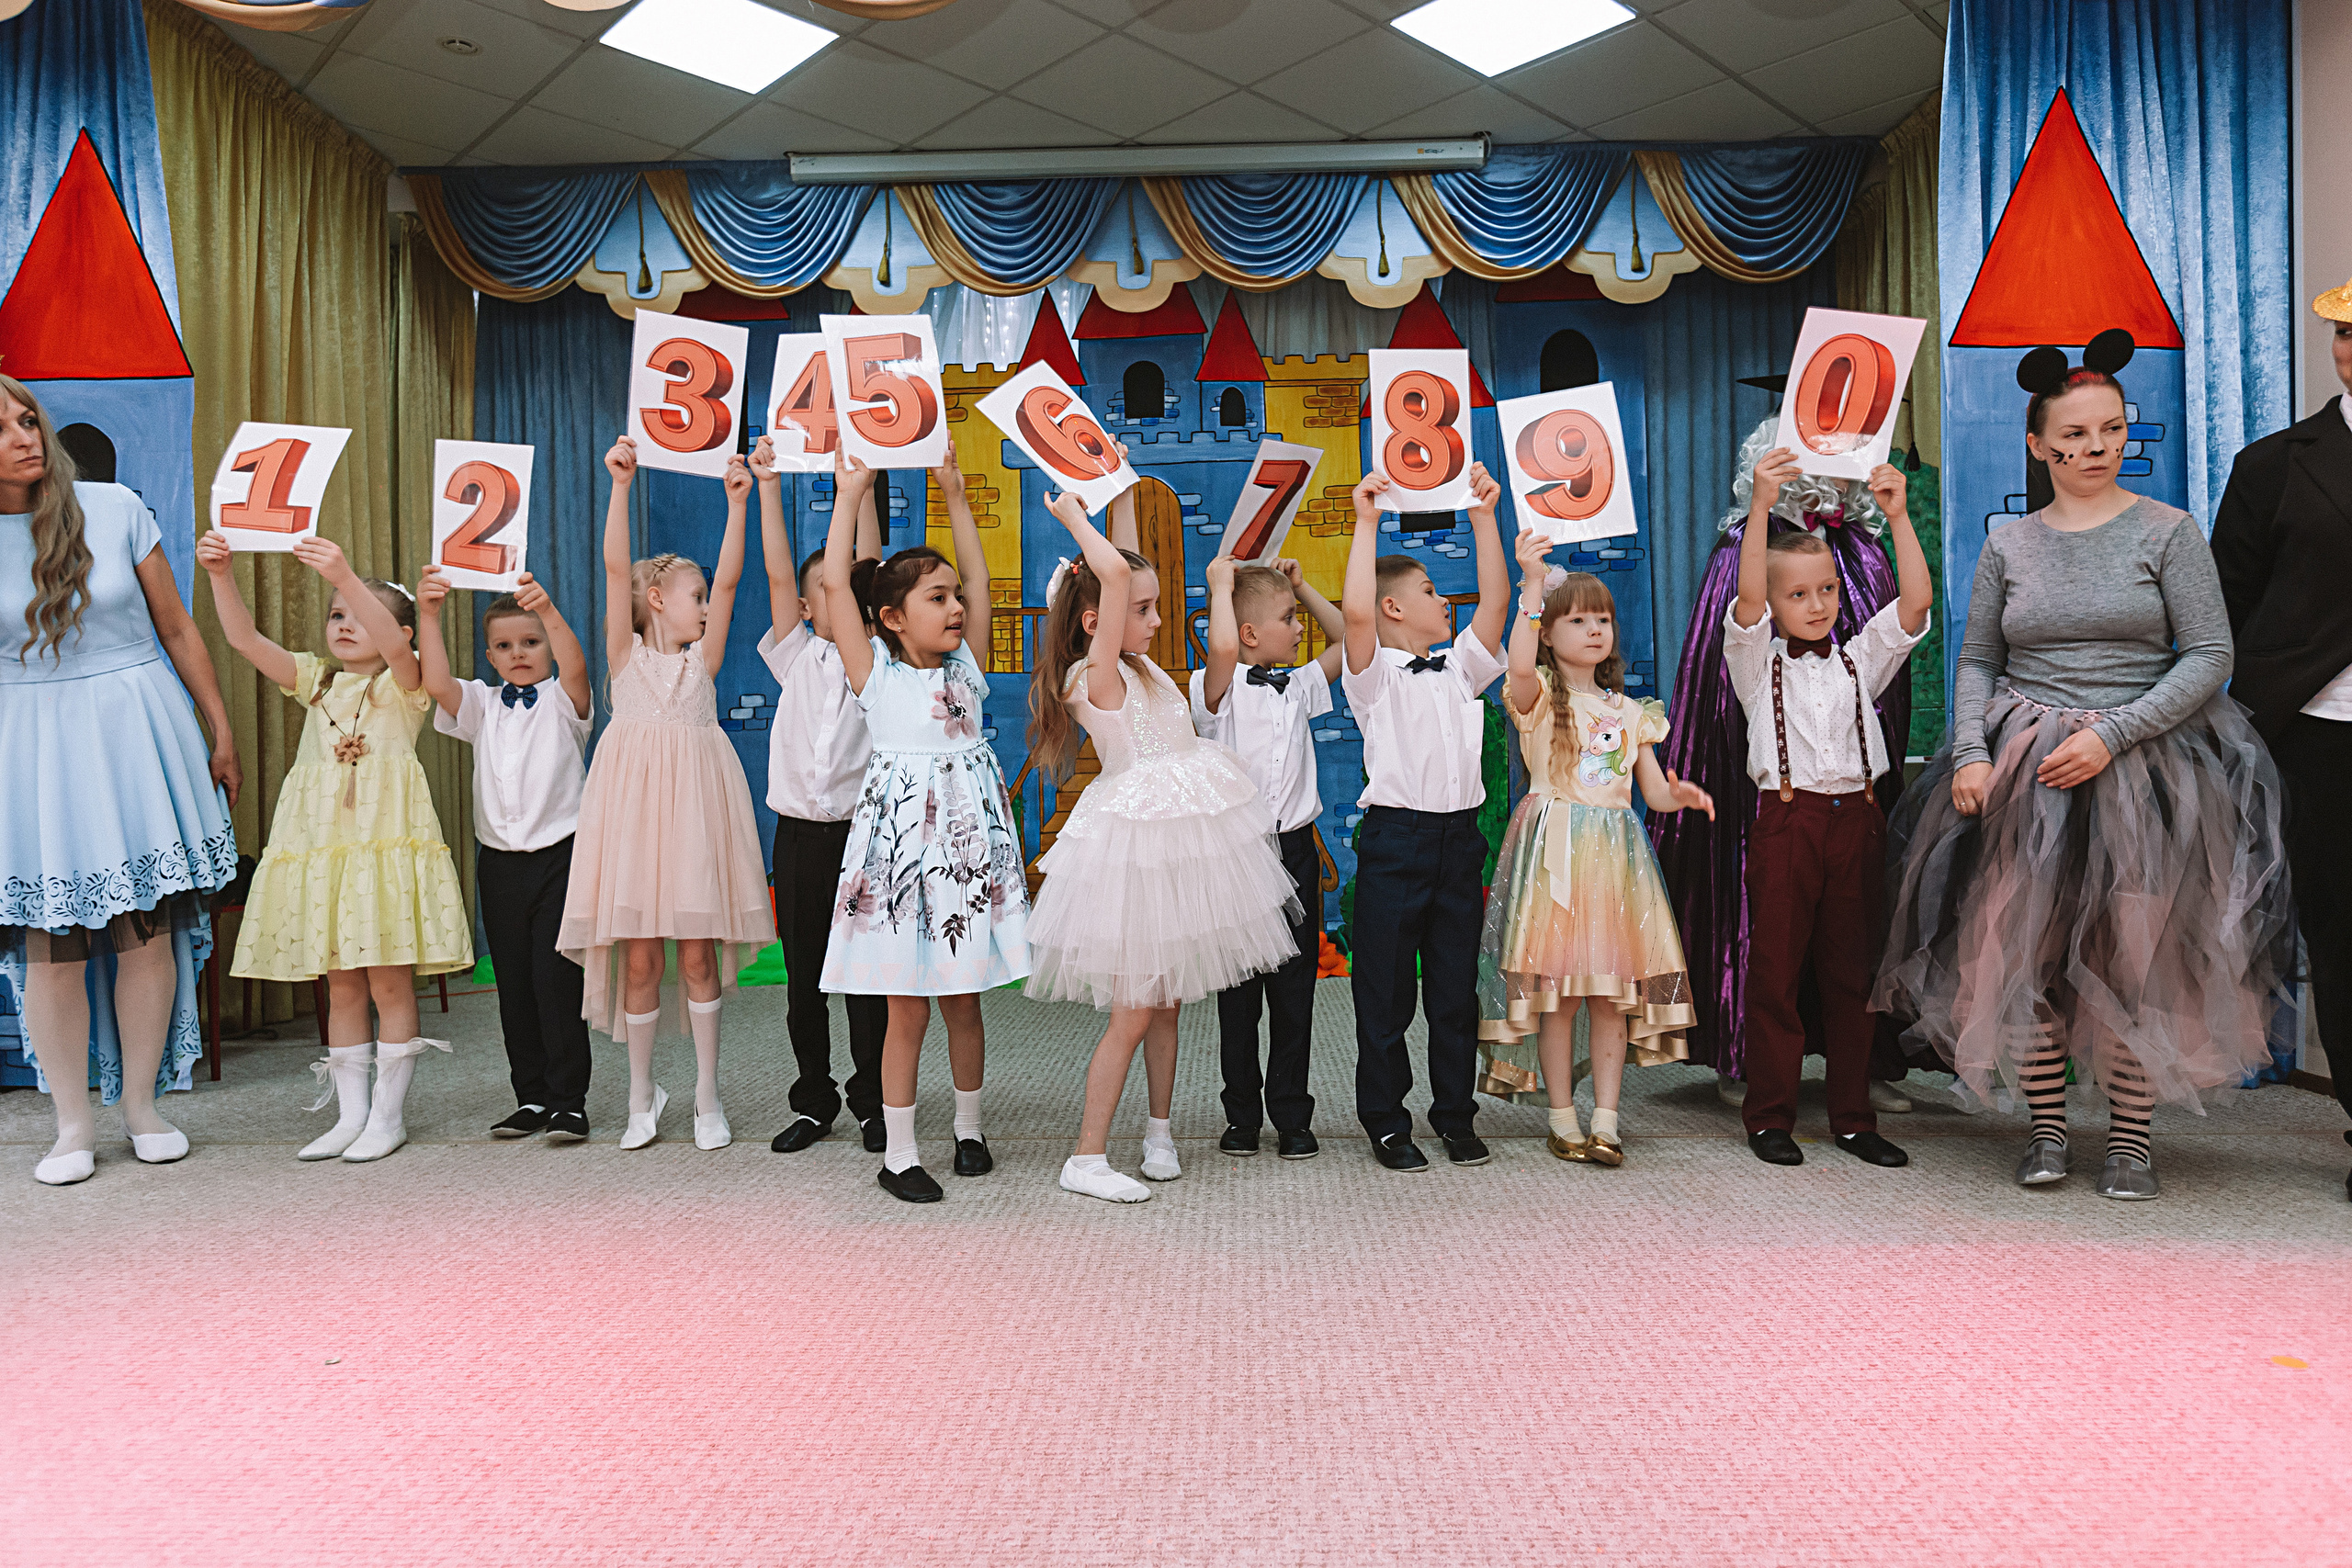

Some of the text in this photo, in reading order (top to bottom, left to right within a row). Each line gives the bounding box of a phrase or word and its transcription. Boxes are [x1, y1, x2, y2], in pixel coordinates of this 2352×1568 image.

[640, 338, 734, 453] 3
[776, 351, 838, 453] 4
[844, 333, 937, 447] 5
[1017, 387, 1121, 480] 6
[1384, 371, 1464, 491] 8
[1795, 334, 1895, 455] 0
[220, 439, 311, 533] 1
[442, 461, 520, 574] 2
[1233, 459, 1310, 560] 7
[1516, 410, 1614, 520] 9
